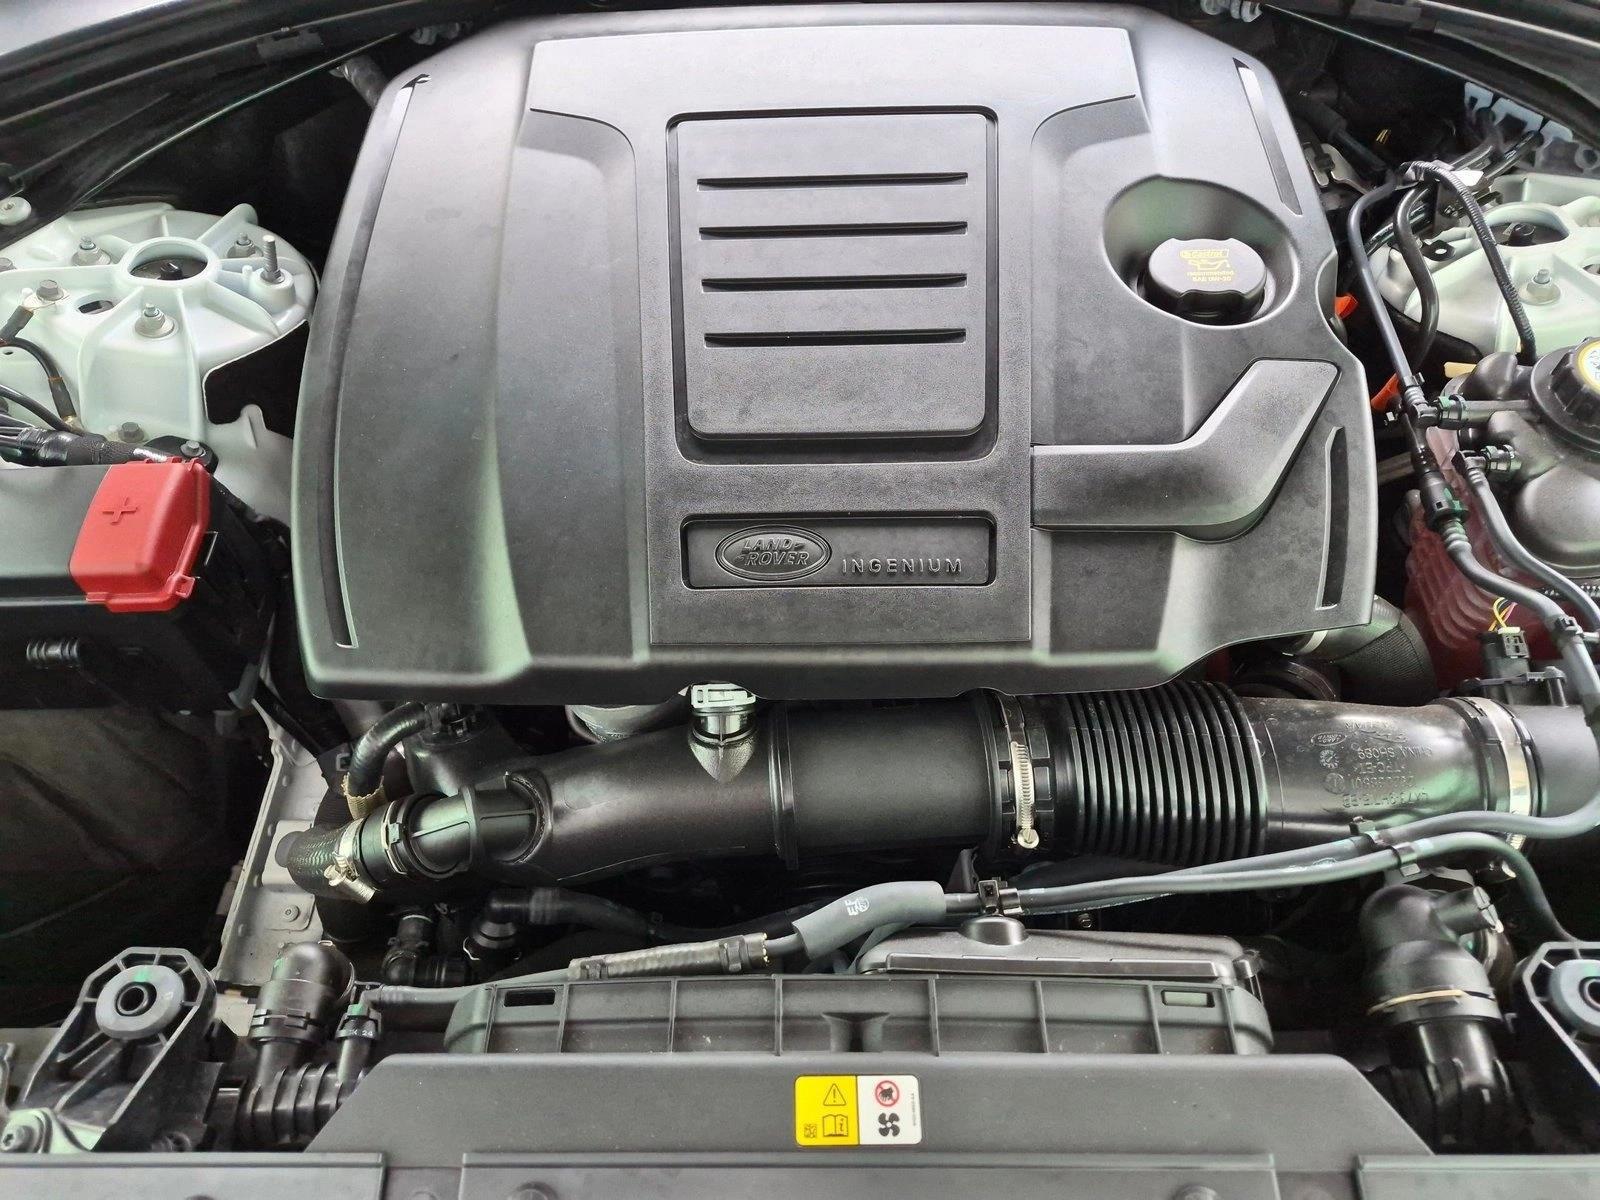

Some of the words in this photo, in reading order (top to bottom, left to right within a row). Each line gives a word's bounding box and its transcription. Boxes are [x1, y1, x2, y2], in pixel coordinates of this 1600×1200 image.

[743, 537, 793, 551] LAND
[745, 551, 810, 566] ROVER
[842, 558, 963, 574] INGENIUM
